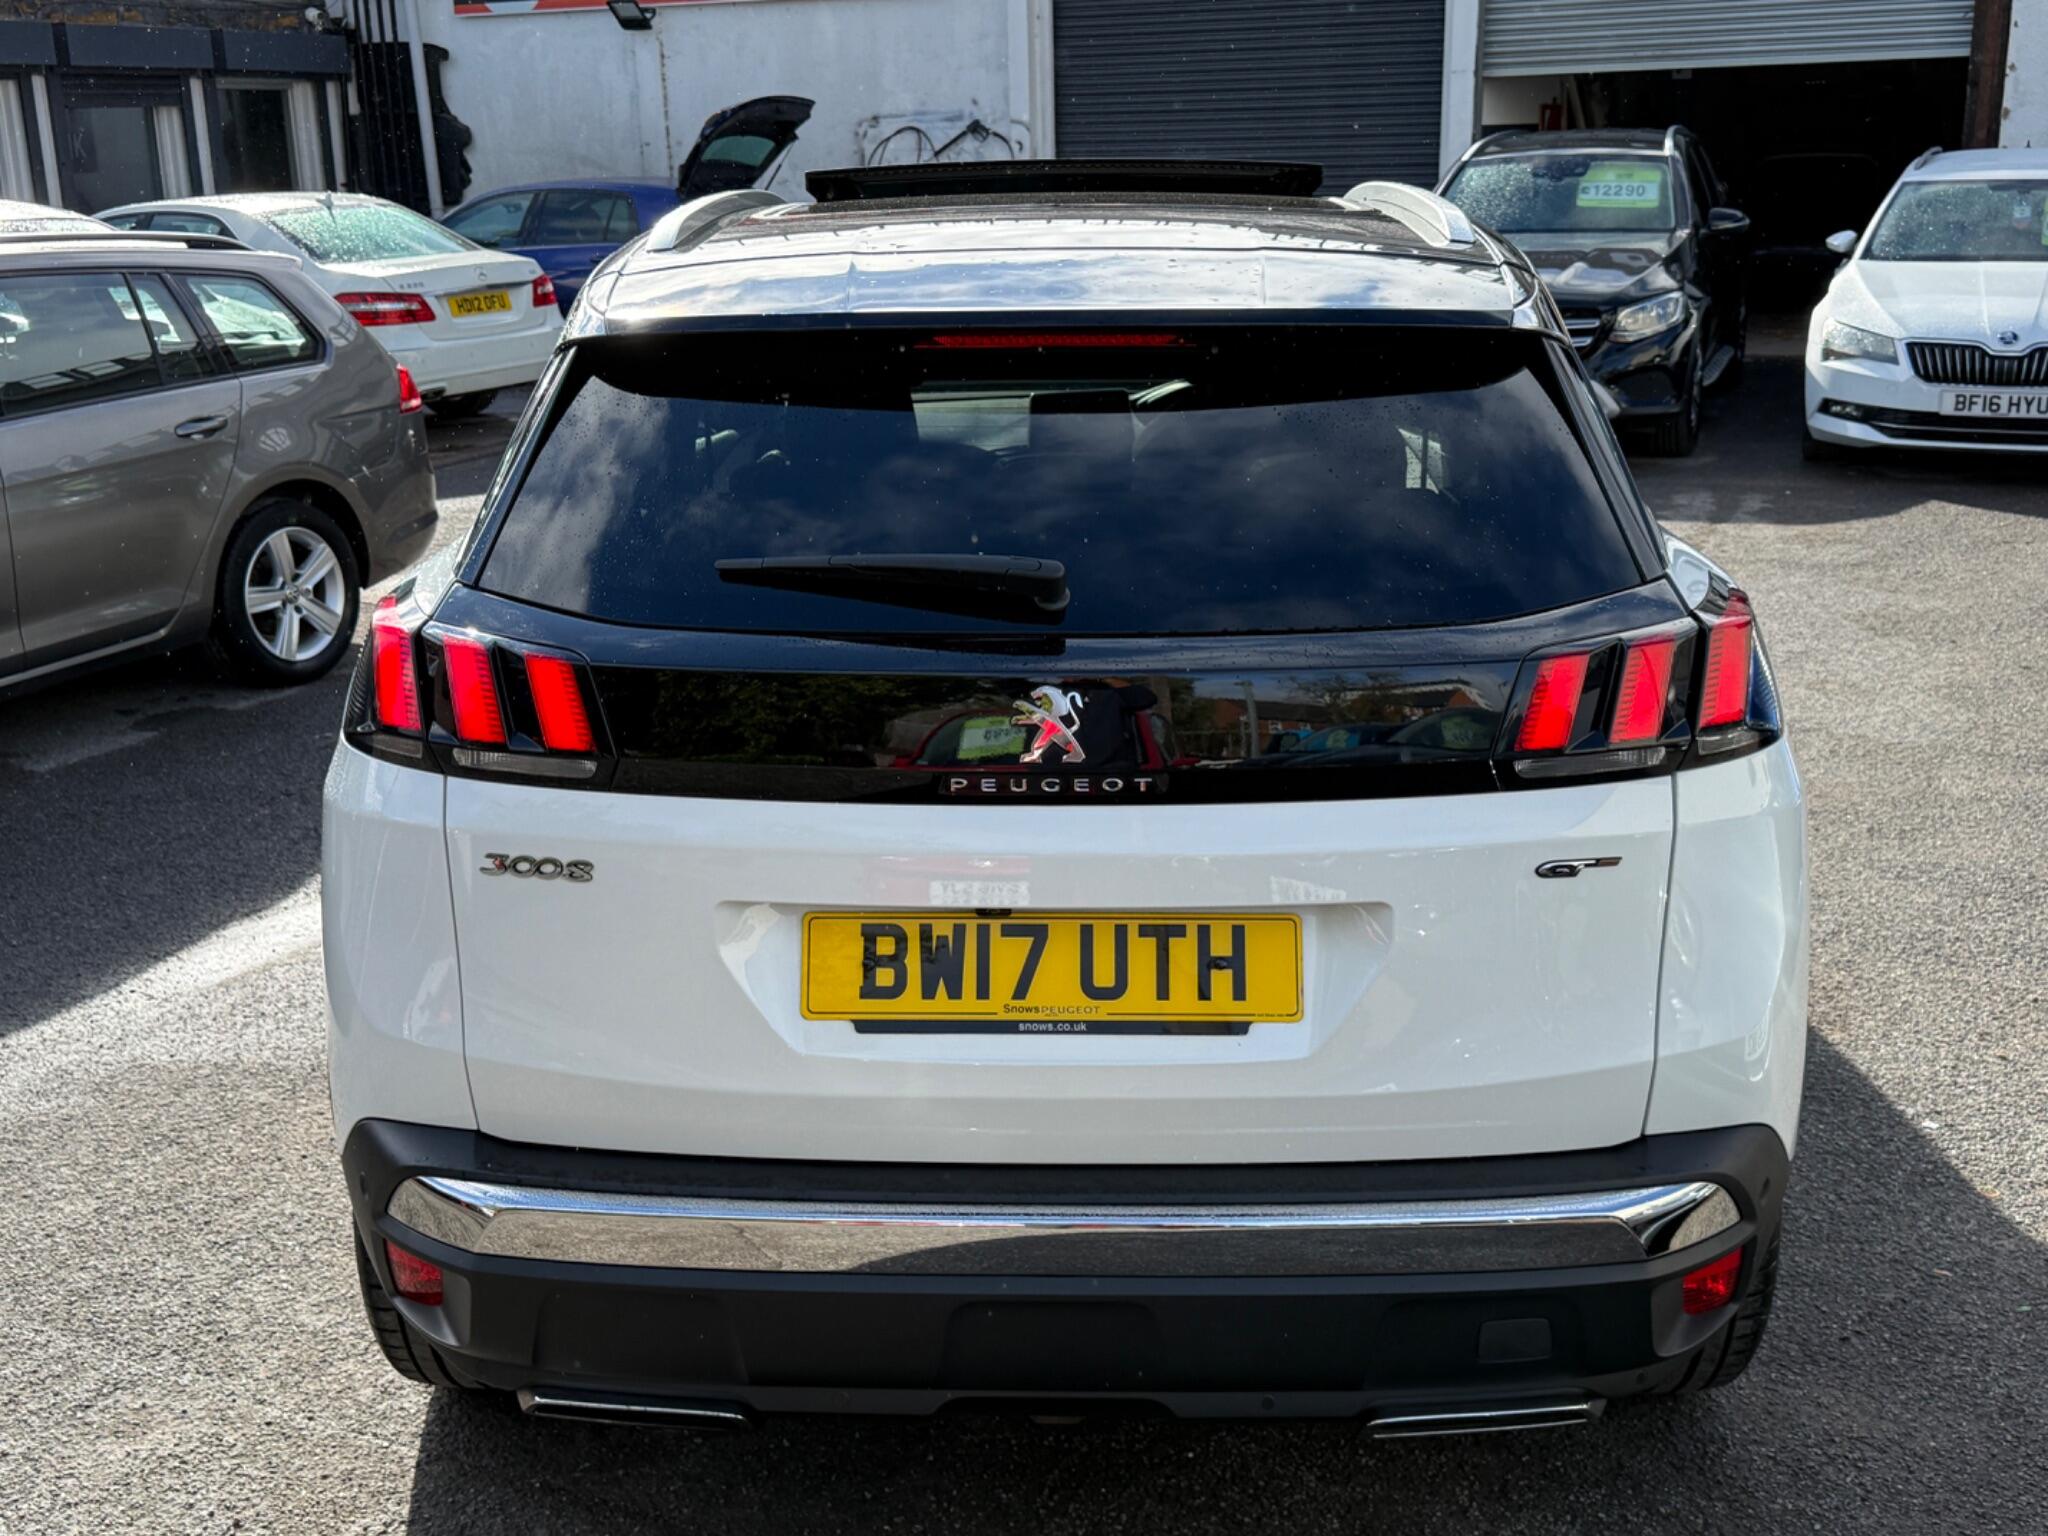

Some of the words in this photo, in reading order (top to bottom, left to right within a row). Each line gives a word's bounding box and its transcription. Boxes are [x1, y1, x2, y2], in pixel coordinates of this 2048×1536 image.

[455, 296, 483, 313] HD12
[1953, 393, 2002, 413] BF16
[2007, 395, 2048, 414] HYU
[950, 778, 1153, 793] PEUGEOT
[479, 852, 594, 883] 3008
[859, 923, 1050, 1001] BW17
[1079, 923, 1247, 1002] UTH
[1018, 1021, 1087, 1032] snows.co.uk
